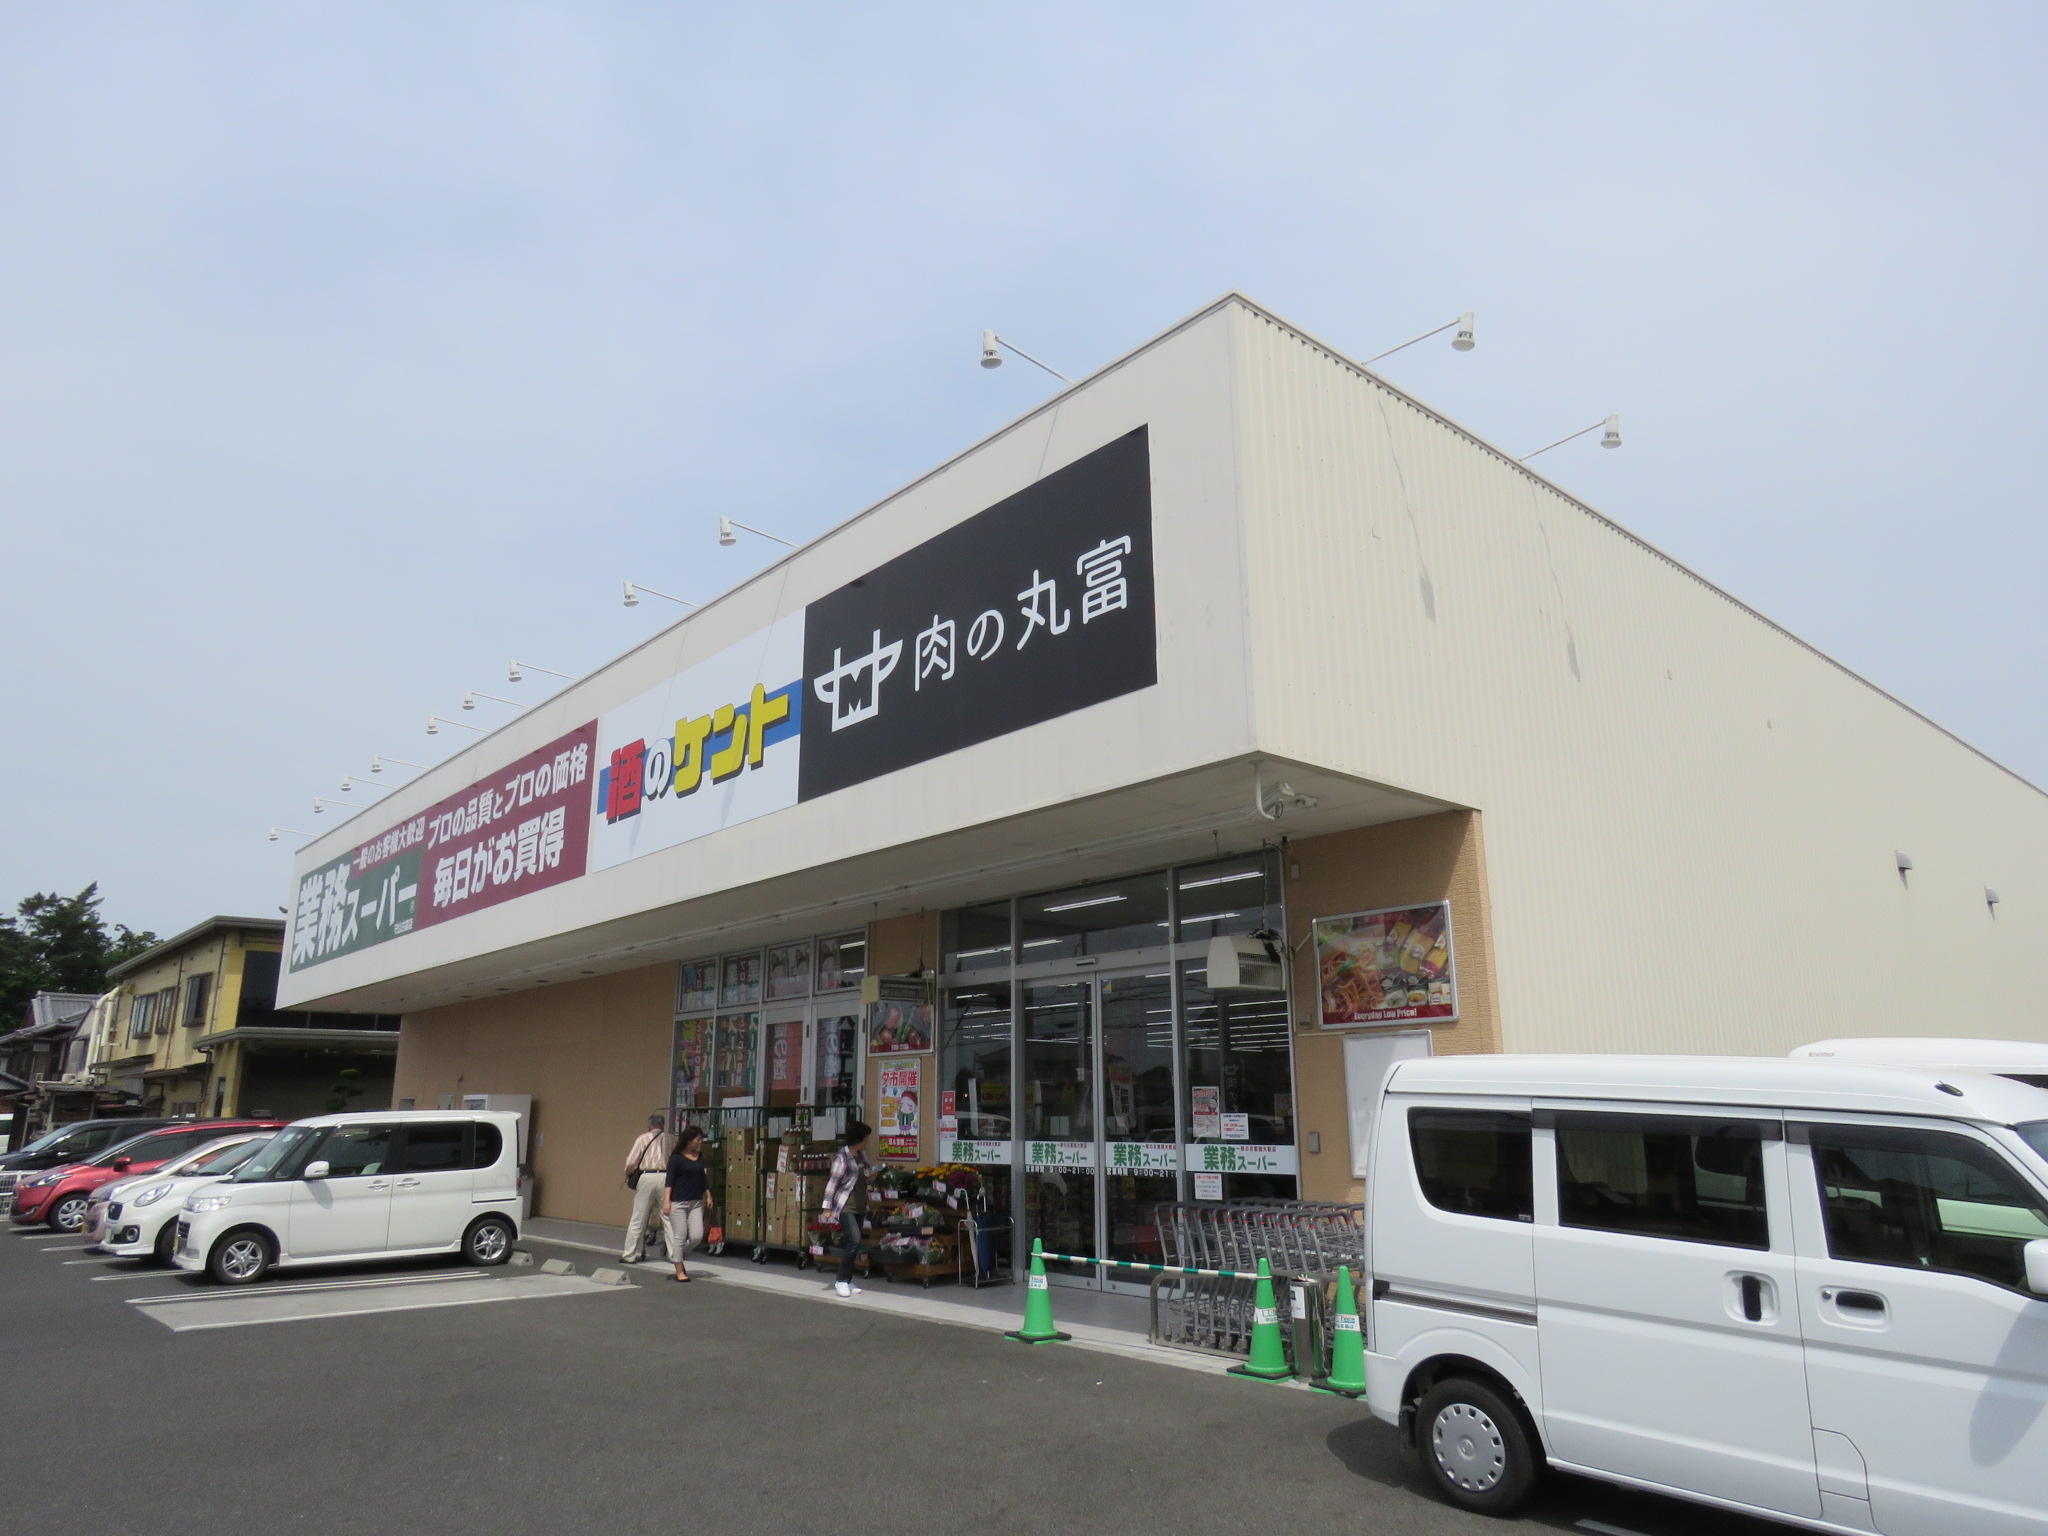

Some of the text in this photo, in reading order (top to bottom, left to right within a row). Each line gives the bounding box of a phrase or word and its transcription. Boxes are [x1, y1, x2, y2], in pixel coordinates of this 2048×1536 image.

[914, 535, 1131, 691] 肉の丸富
[606, 683, 789, 825] 酒のケント
[428, 743, 588, 850] プロの品質とプロの価格
[353, 816, 426, 870] 一般のお客様大歓迎
[433, 806, 566, 908] 毎日がお買得
[292, 863, 418, 966] 業務スーパー
[1354, 1011, 1382, 1020] Everyday
[1383, 1010, 1397, 1018] Low
[952, 1141, 1001, 1162] 業務スーパー
[1032, 1142, 1087, 1164] 業務スーパー
[1113, 1143, 1176, 1167] 業務スーパー
[1204, 1145, 1277, 1171] 業務スーパー
